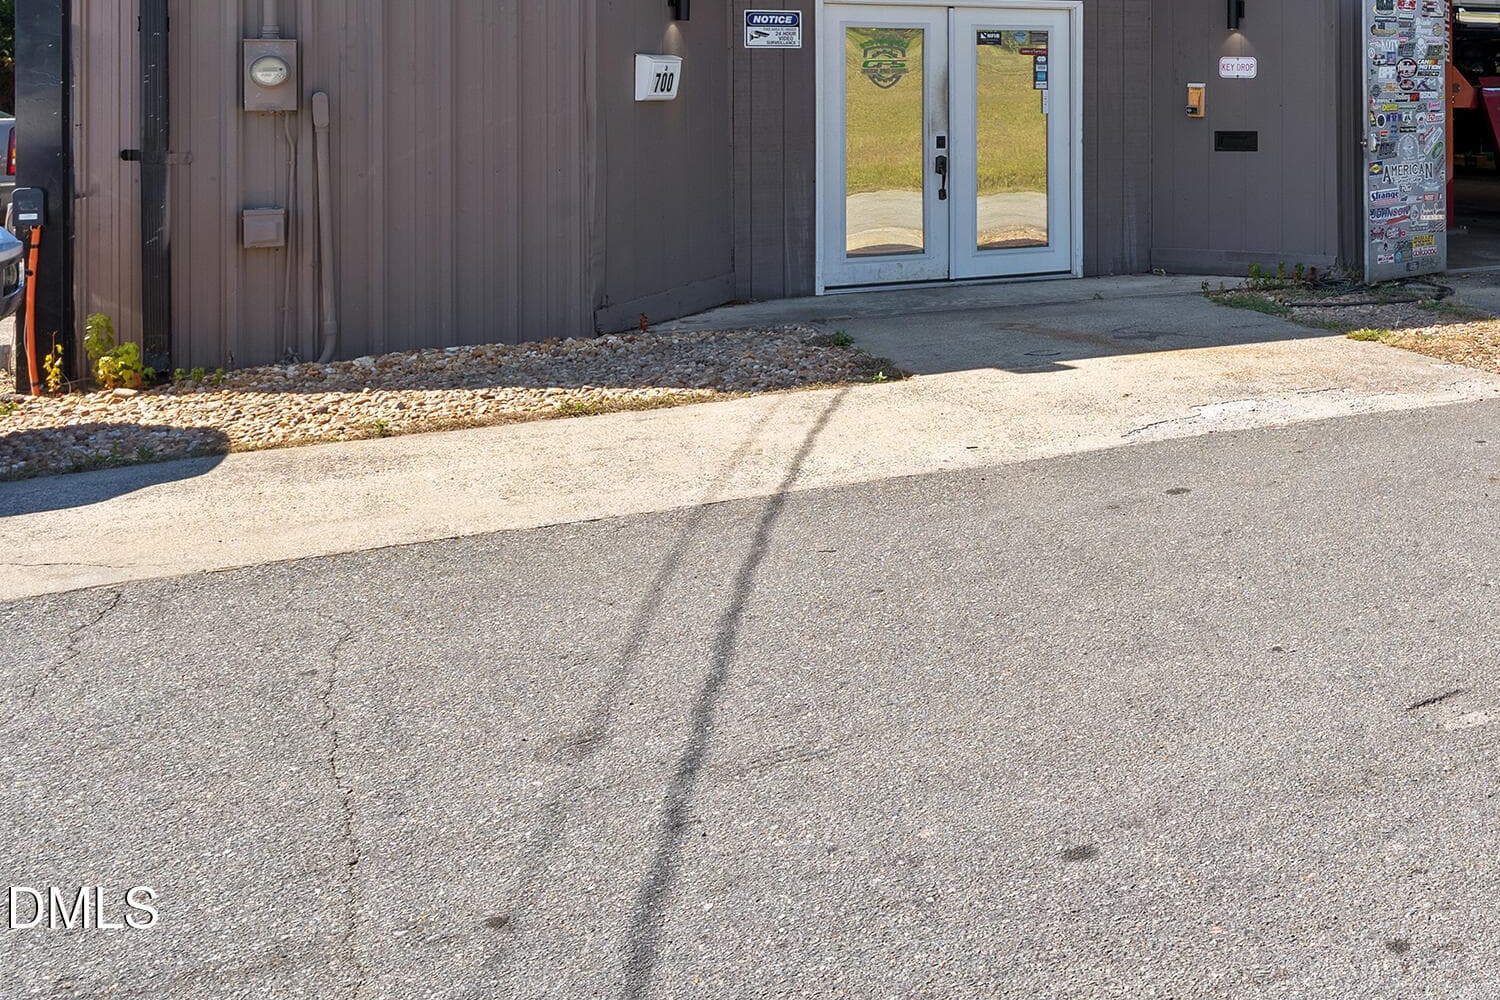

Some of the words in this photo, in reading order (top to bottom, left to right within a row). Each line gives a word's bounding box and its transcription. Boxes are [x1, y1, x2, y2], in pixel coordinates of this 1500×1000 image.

[752, 15, 793, 24] NOTICE
[1221, 63, 1236, 71] KEY
[1237, 63, 1254, 71] DROP
[654, 72, 674, 93] 700
[1382, 162, 1433, 183] AMERICAN
[1371, 191, 1400, 202] Strange
[1370, 205, 1411, 220] JOHNSON
